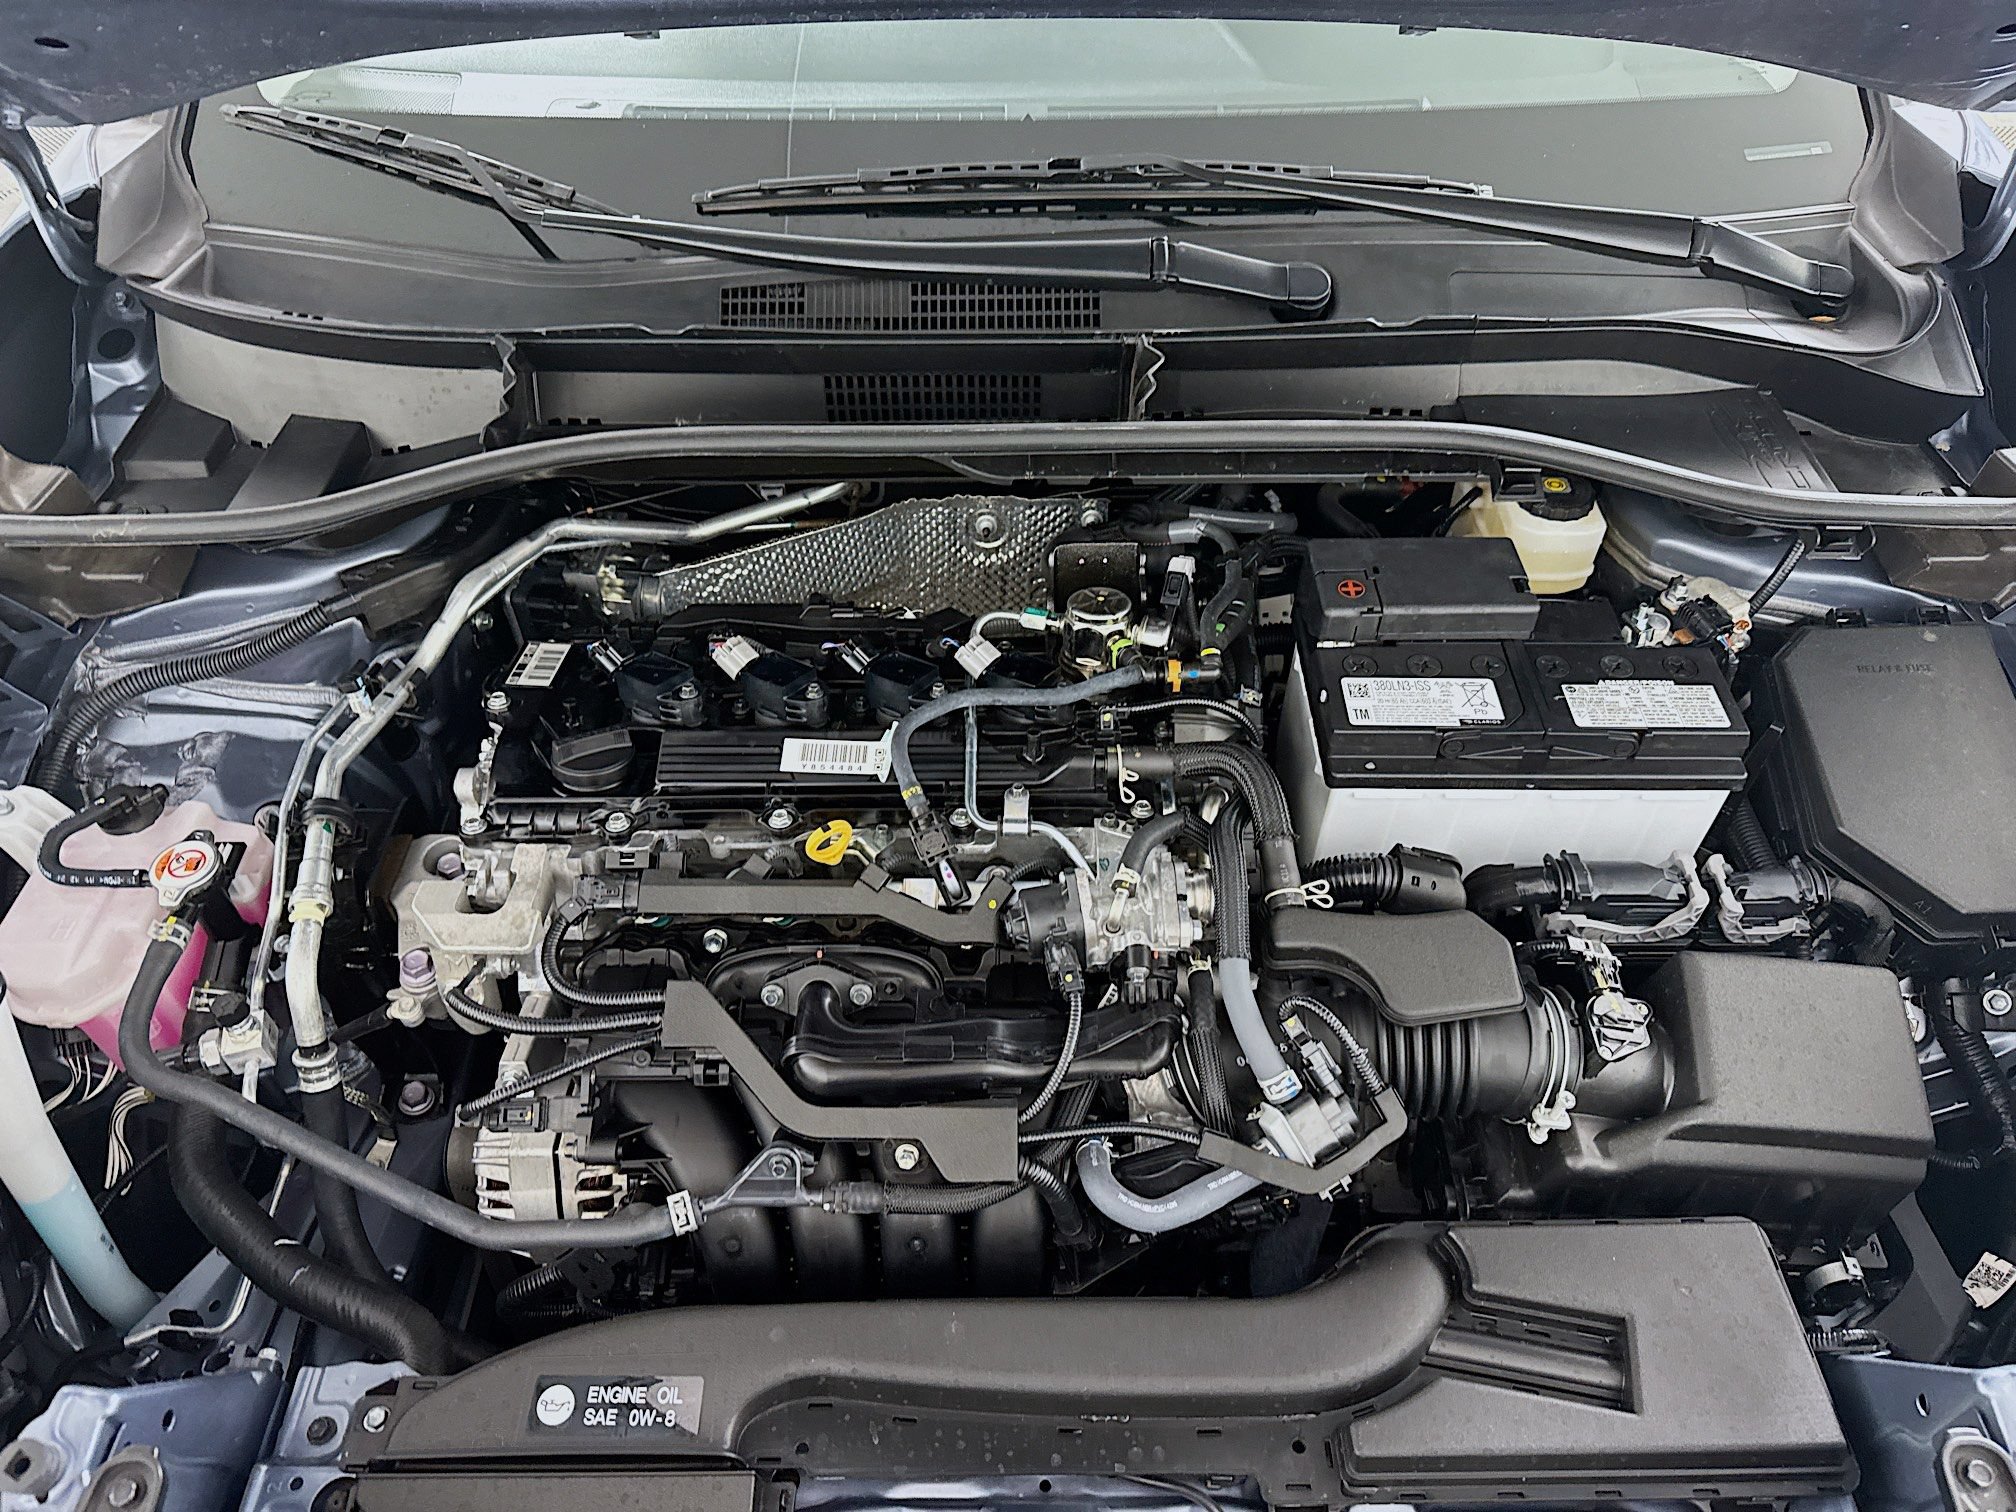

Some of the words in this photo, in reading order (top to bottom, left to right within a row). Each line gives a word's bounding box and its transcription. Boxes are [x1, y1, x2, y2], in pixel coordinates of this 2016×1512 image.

[1856, 664, 1892, 673] RELAY
[1374, 680, 1432, 692] 380LN3-ISS
[1352, 708, 1370, 720] TM
[586, 1385, 648, 1405] ENGINE
[656, 1386, 684, 1405] OIL
[583, 1407, 619, 1426] SAE
[628, 1409, 677, 1428] 0W-8
